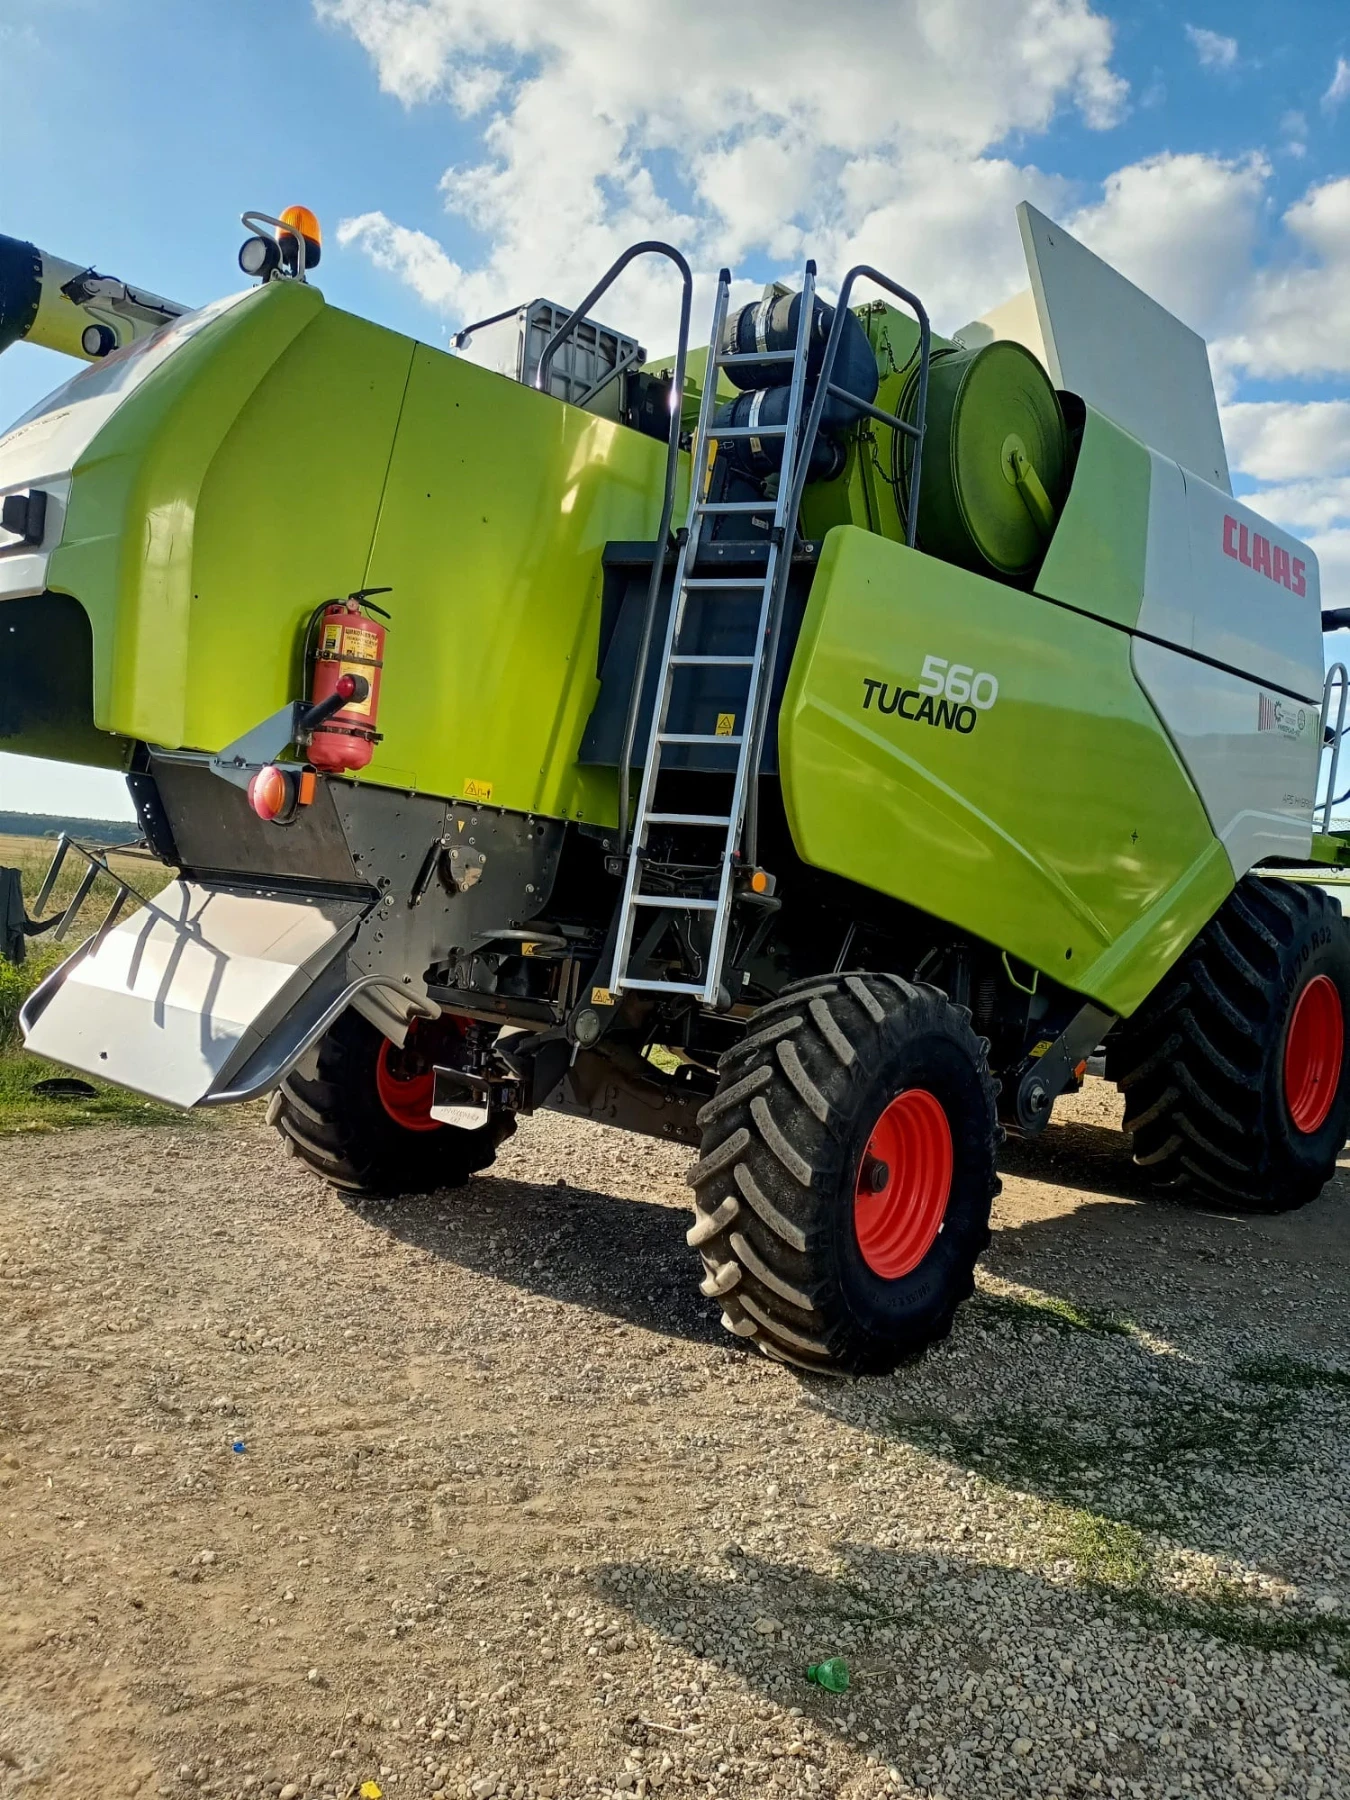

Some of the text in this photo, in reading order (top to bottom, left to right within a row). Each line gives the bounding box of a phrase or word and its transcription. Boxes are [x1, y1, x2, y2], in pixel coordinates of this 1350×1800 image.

[1223, 514, 1306, 598] CLAAS
[863, 678, 977, 734] TUCANO
[918, 654, 999, 710] 560
